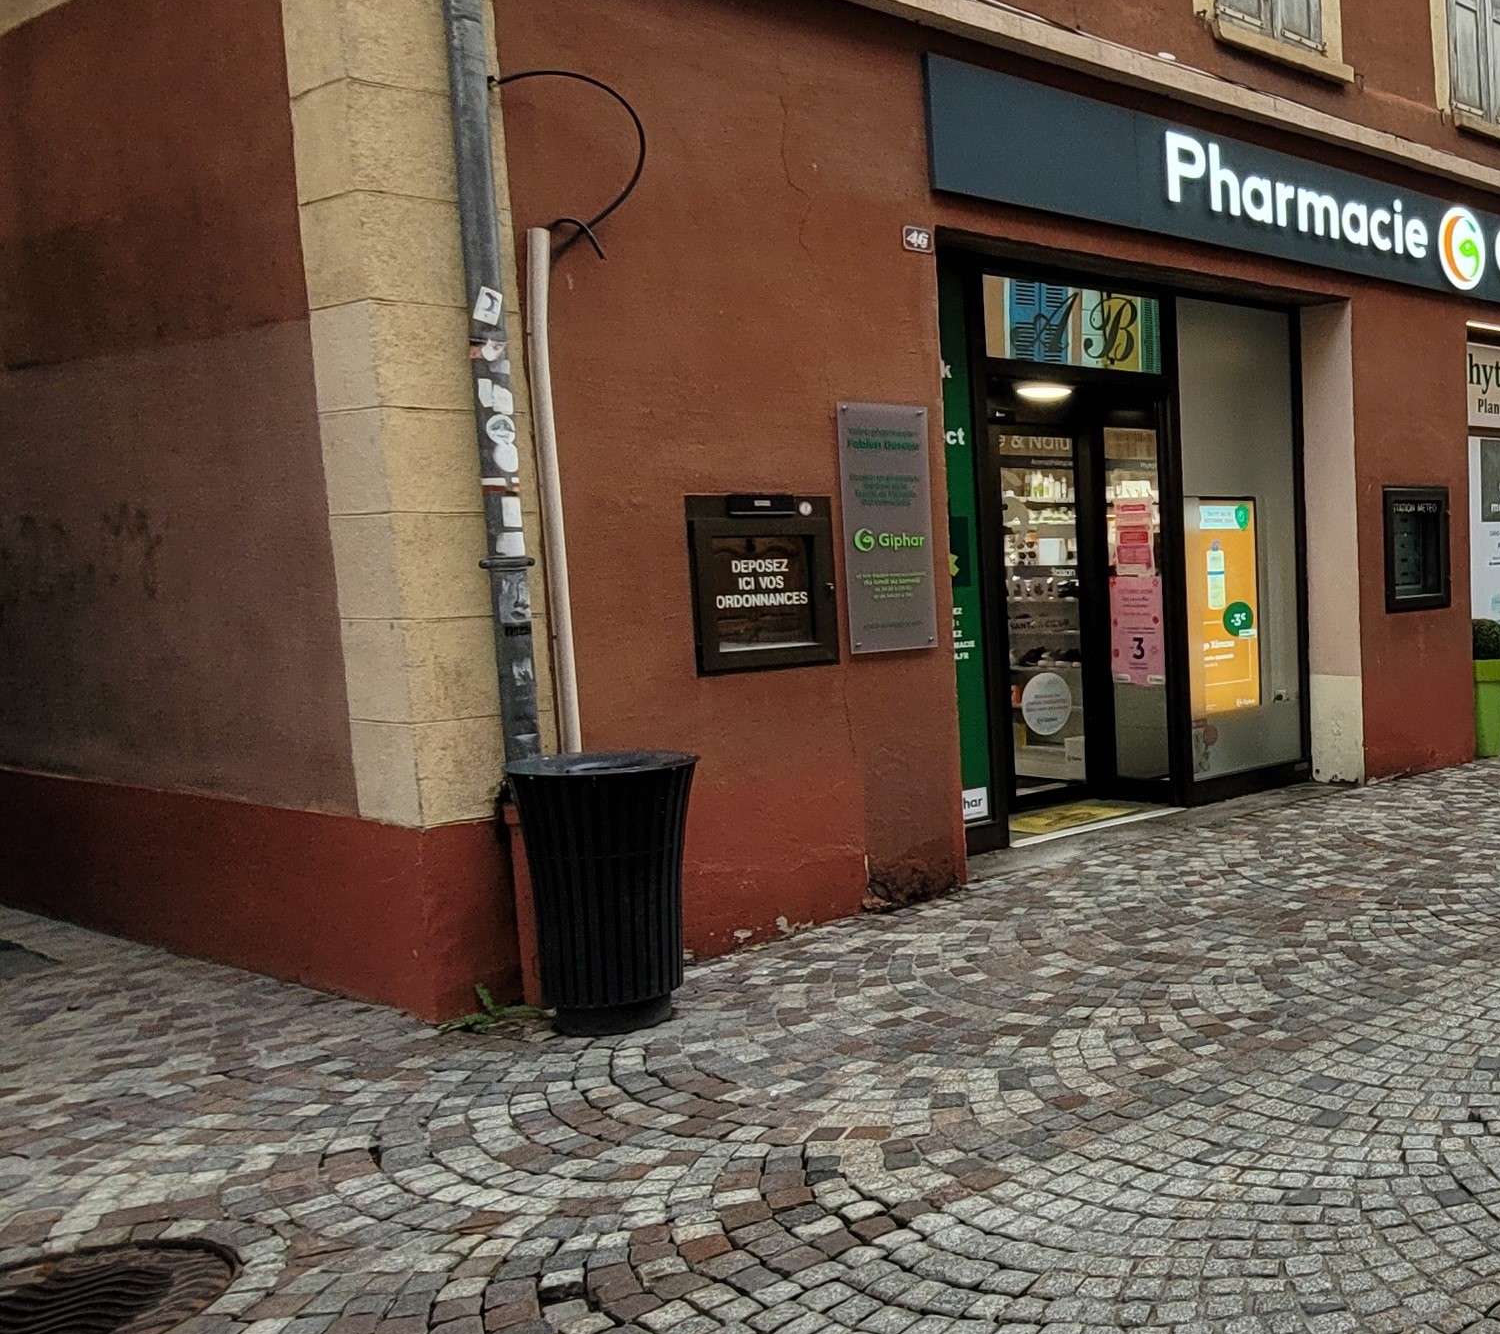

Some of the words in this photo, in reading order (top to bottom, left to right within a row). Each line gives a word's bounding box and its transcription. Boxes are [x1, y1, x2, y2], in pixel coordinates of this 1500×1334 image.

[1164, 129, 1429, 259] Pharmacie
[906, 230, 929, 249] 46
[879, 531, 925, 550] Giphar
[731, 559, 789, 573] DEPOSEZ
[738, 577, 755, 590] ICI
[759, 575, 785, 589] VOS
[716, 591, 808, 609] ORDONNANCES
[963, 794, 983, 809] har
